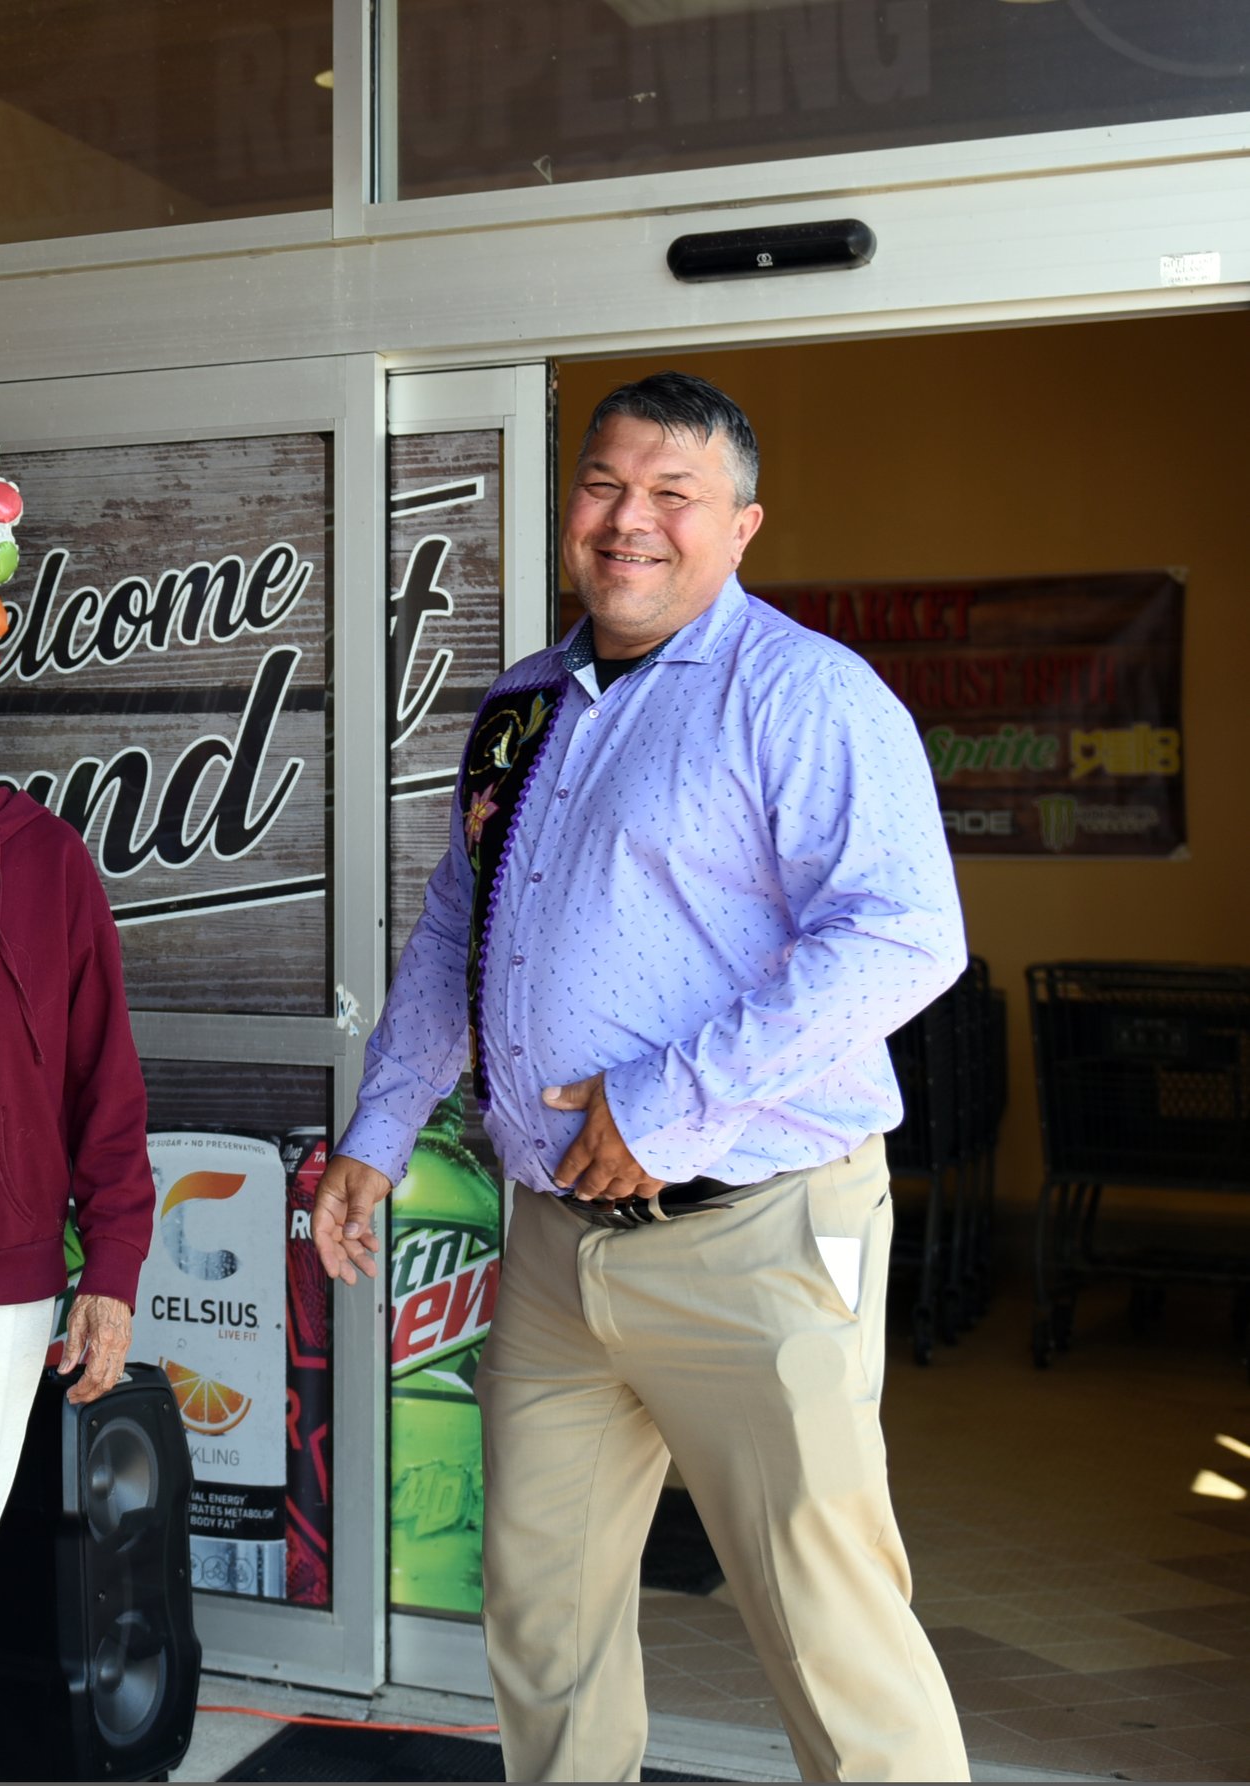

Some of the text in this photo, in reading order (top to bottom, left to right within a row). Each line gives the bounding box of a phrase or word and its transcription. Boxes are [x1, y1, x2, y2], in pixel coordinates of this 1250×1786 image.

[926, 726, 1059, 781] Sprite
[157, 1139, 182, 1147] SUGAR
[151, 1295, 258, 1329] CELSIUS
[218, 1329, 257, 1342] LIVE FIT
